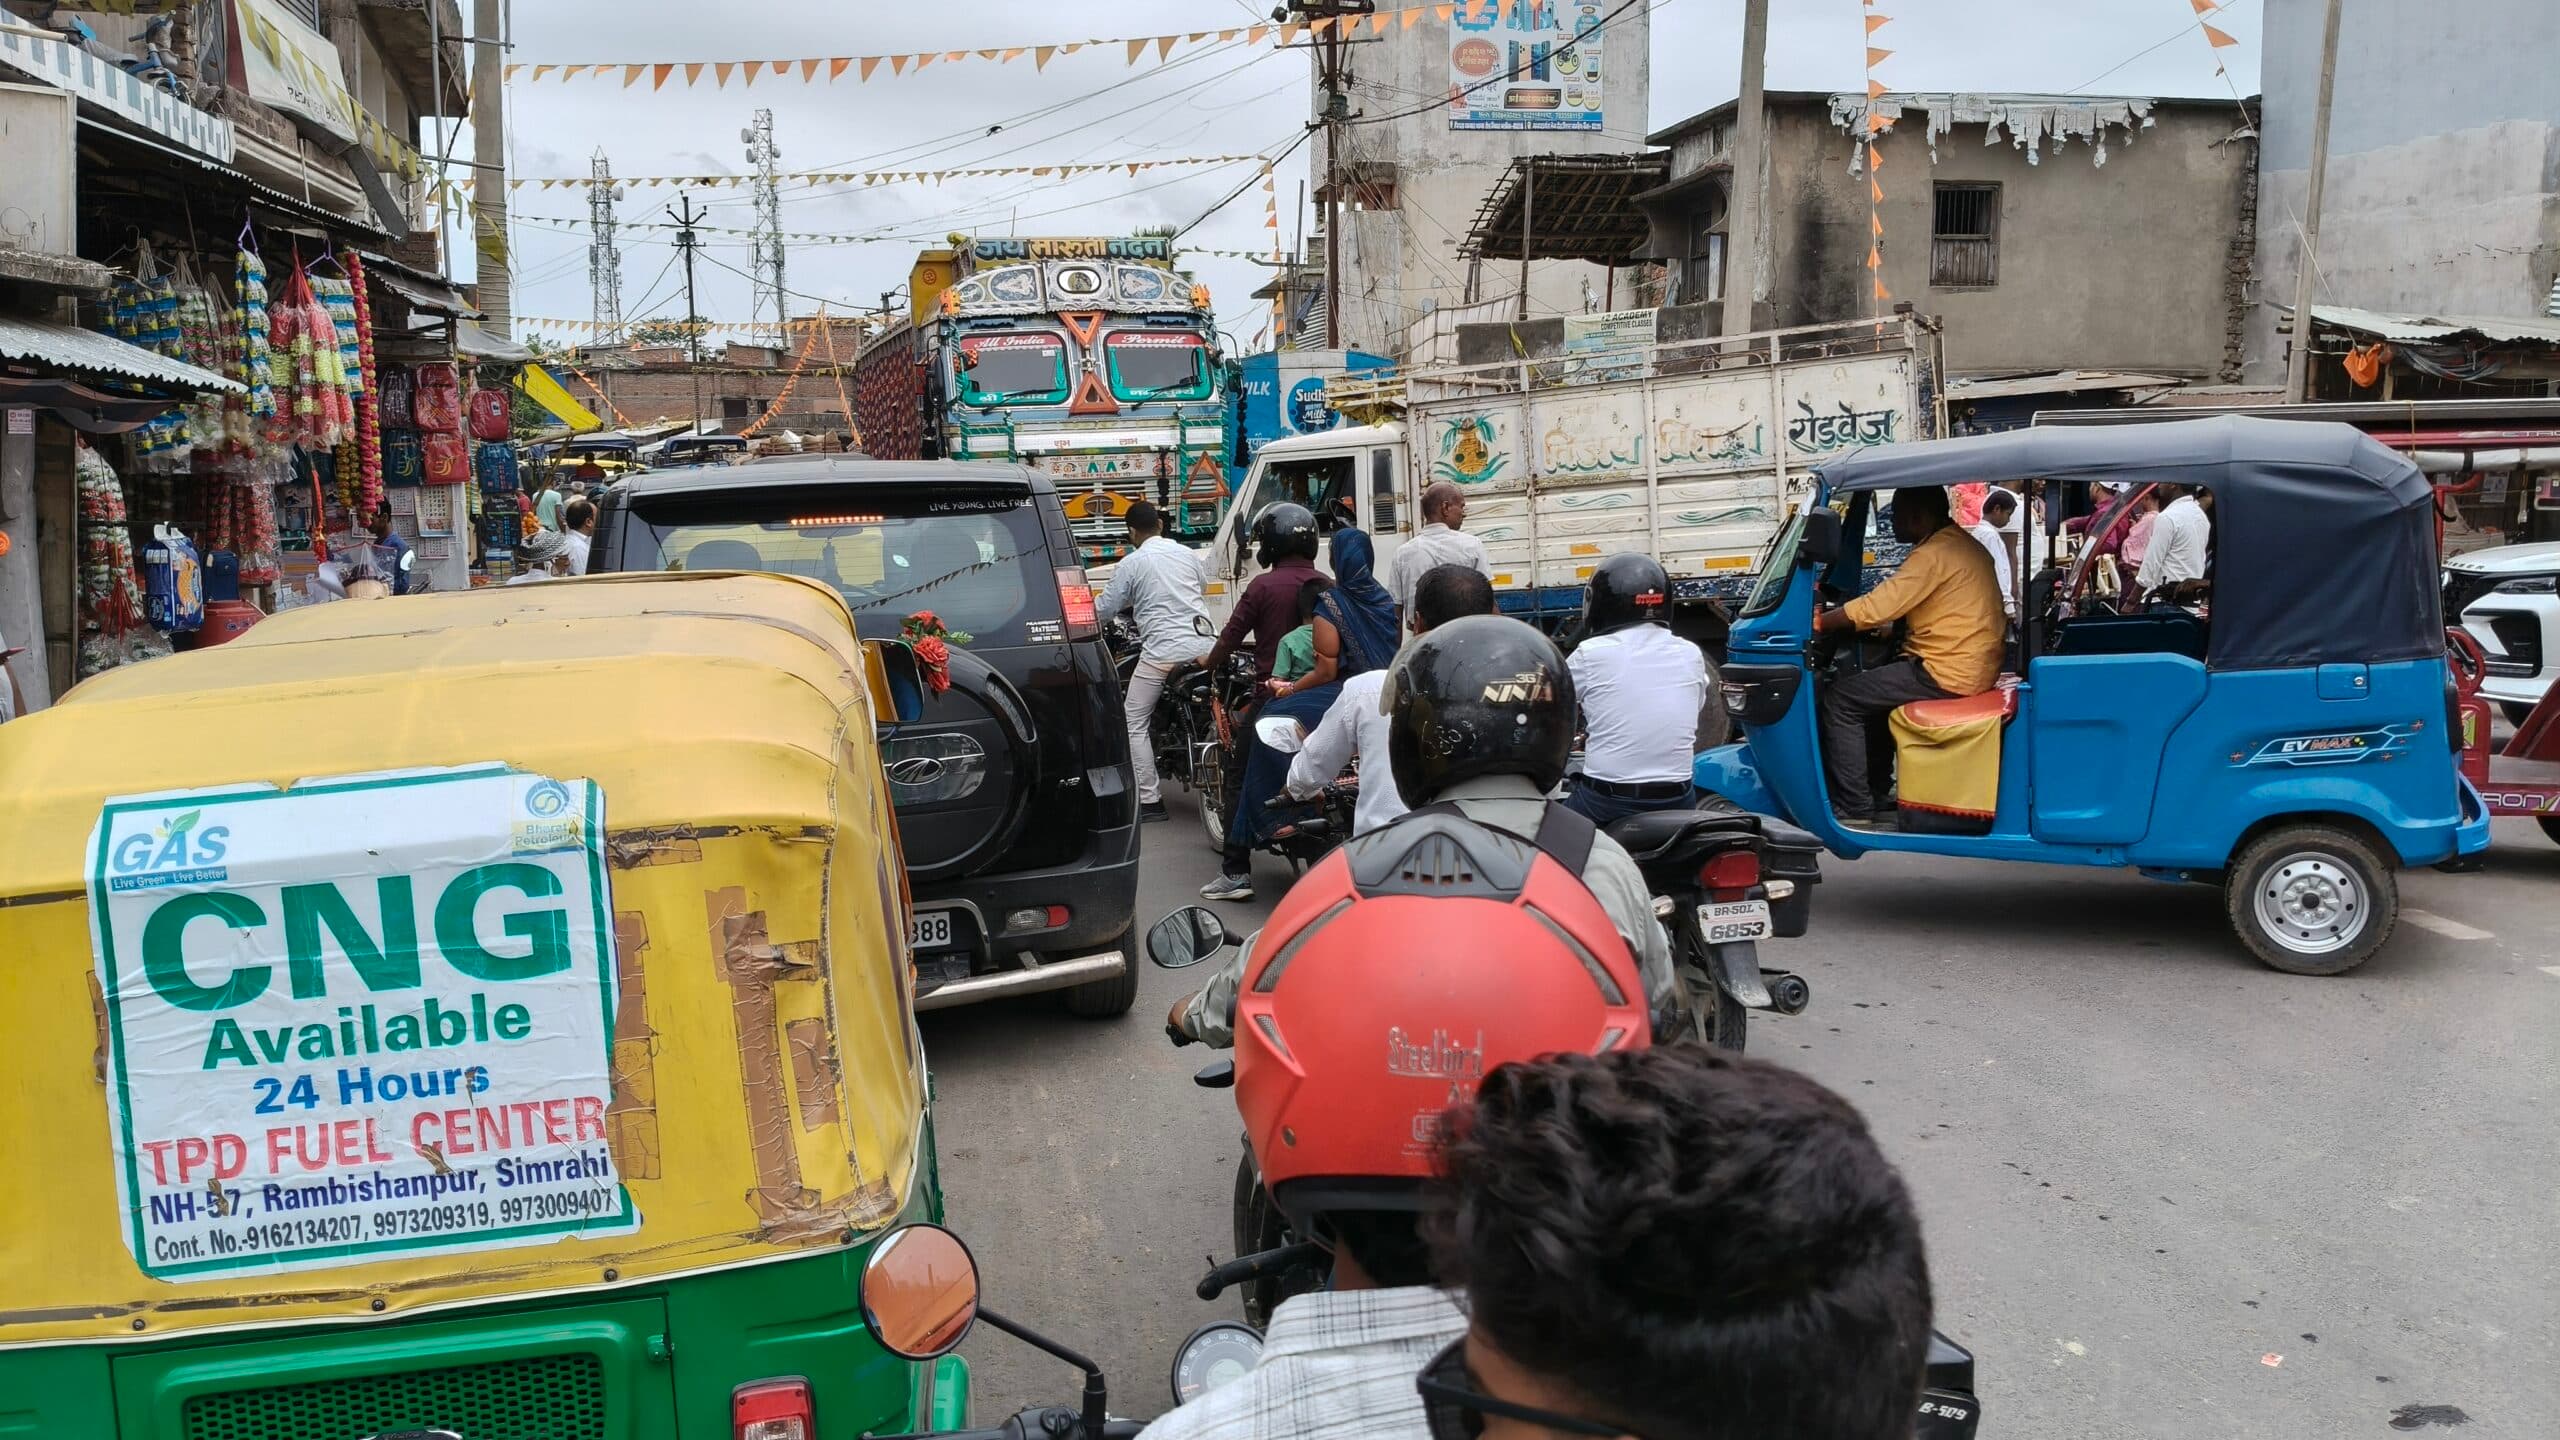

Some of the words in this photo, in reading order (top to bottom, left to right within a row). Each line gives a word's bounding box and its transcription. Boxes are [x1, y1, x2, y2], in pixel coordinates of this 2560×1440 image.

[975, 238, 1030, 261] जय
[1601, 321, 1632, 331] COMPETITIVE
[1632, 318, 1653, 328] CLASSES
[1612, 310, 1653, 321] ACADEMY
[974, 338, 1000, 348] All
[1004, 337, 1046, 346] India
[1121, 333, 1188, 344] Permit
[1788, 399, 1896, 453] रोडवेज
[930, 502, 951, 512] LIVE
[987, 500, 1008, 509] LIVE
[1009, 498, 1033, 507] FREE
[1515, 673, 1537, 684] 3G
[113, 826, 230, 874] GAS
[113, 876, 136, 889] Live
[137, 874, 166, 887] Green
[172, 871, 195, 883] Live
[195, 868, 226, 881] Better
[141, 862, 573, 1013] CNG
[1710, 922, 1765, 940] 6853
[202, 993, 532, 1071] Available
[253, 1073, 320, 1115] 24
[339, 1062, 490, 1107] Hours
[142, 1133, 248, 1187] TPD
[265, 1118, 394, 1176] FUEL
[410, 1096, 608, 1156] CENTER
[263, 1168, 487, 1213] Rambishanpur,
[496, 1148, 609, 1188] Simrahi
[155, 1235, 206, 1262] Cont.
[373, 1200, 496, 1237] 9973209319,
[500, 1188, 612, 1223] 9973009407
